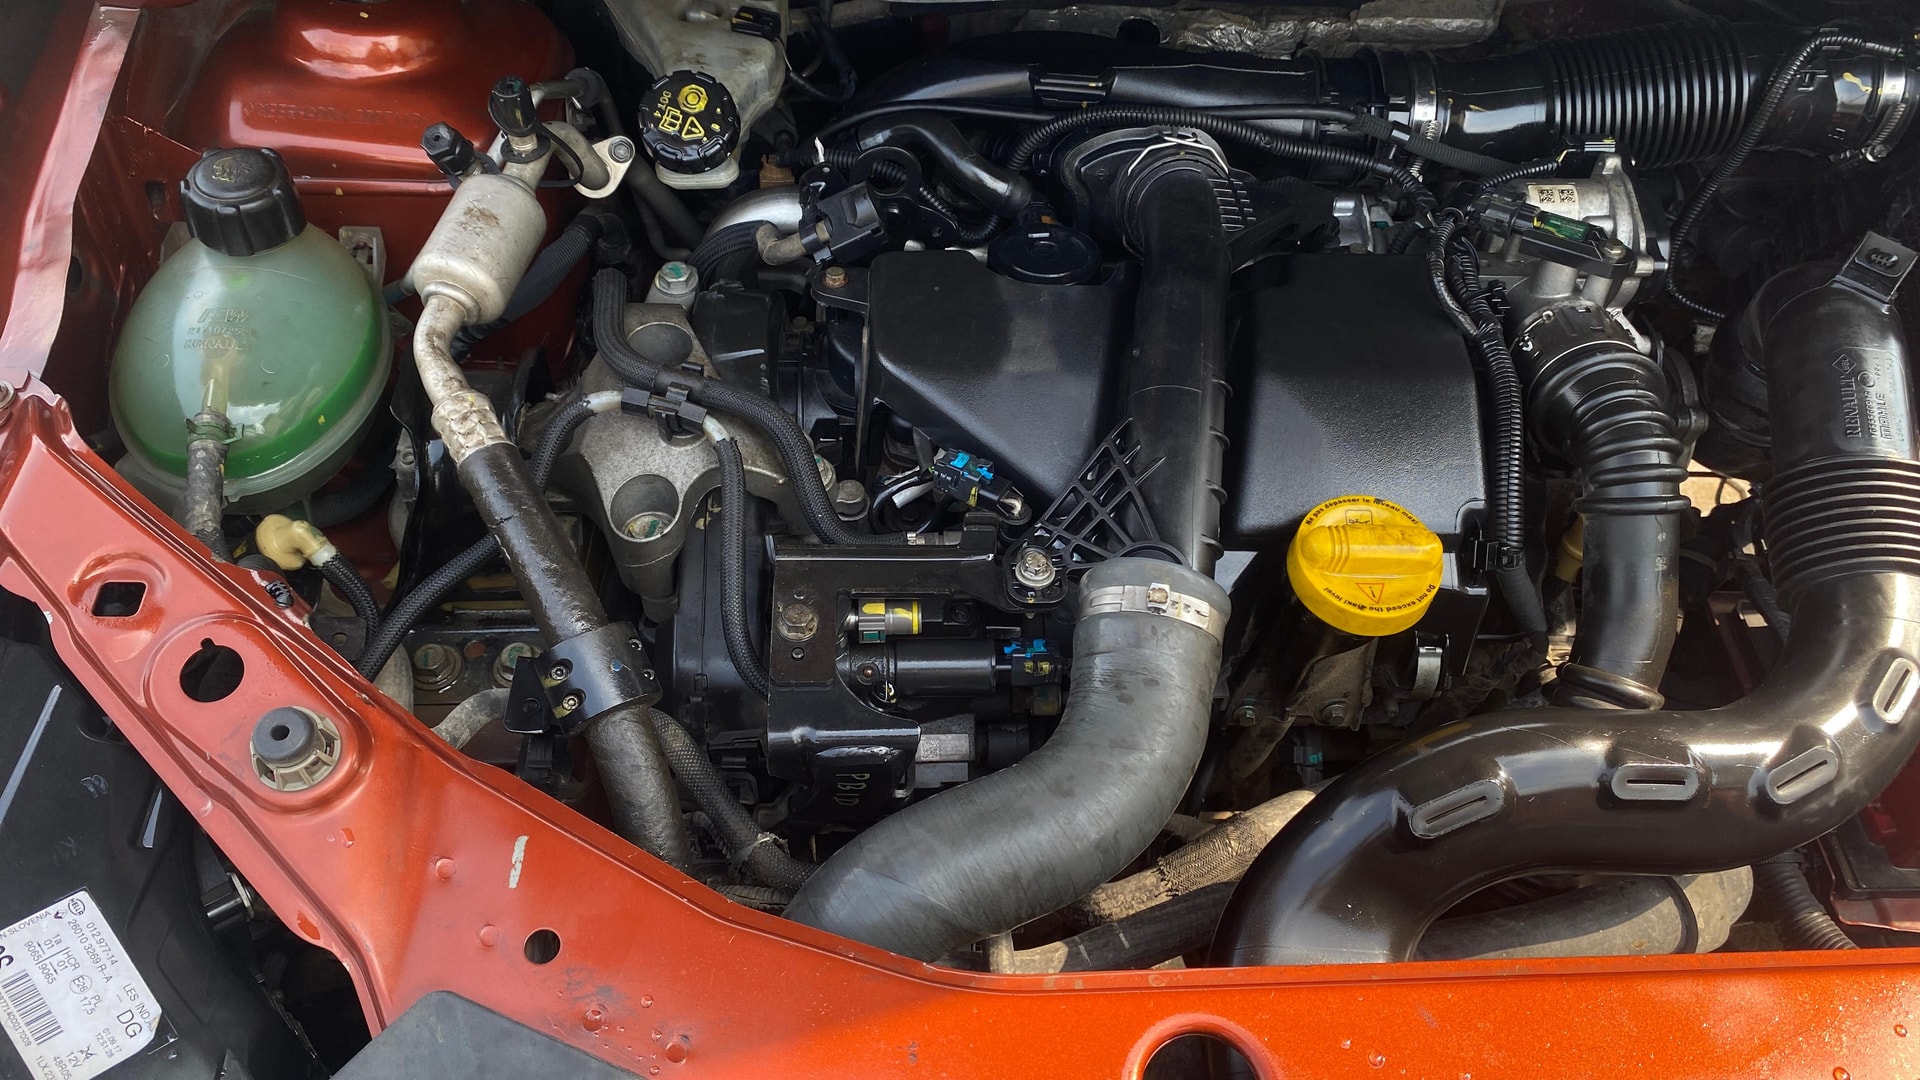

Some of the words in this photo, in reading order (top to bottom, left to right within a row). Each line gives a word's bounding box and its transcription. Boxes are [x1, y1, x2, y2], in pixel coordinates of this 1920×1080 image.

[653, 110, 662, 118] 4
[1839, 375, 1862, 438] RENAULT
[1313, 507, 1324, 518] pas
[1323, 587, 1343, 601] level
[1417, 592, 1428, 602] not
[1426, 584, 1436, 593] Do
[1386, 601, 1416, 612] exceed
[8, 911, 51, 935] SLOVENIA
[68, 919, 88, 944] 26010
[84, 944, 101, 964] 3269
[24, 941, 43, 961] 9065
[39, 963, 56, 984] 9065
[44, 939, 55, 950] 01
[57, 960, 68, 971] 01
[62, 950, 80, 971] HCR
[72, 975, 88, 993] E26
[123, 983, 139, 1001] LES
[90, 995, 102, 1008] PL
[116, 1009, 142, 1039] DG
[66, 1051, 83, 1068] 12V
